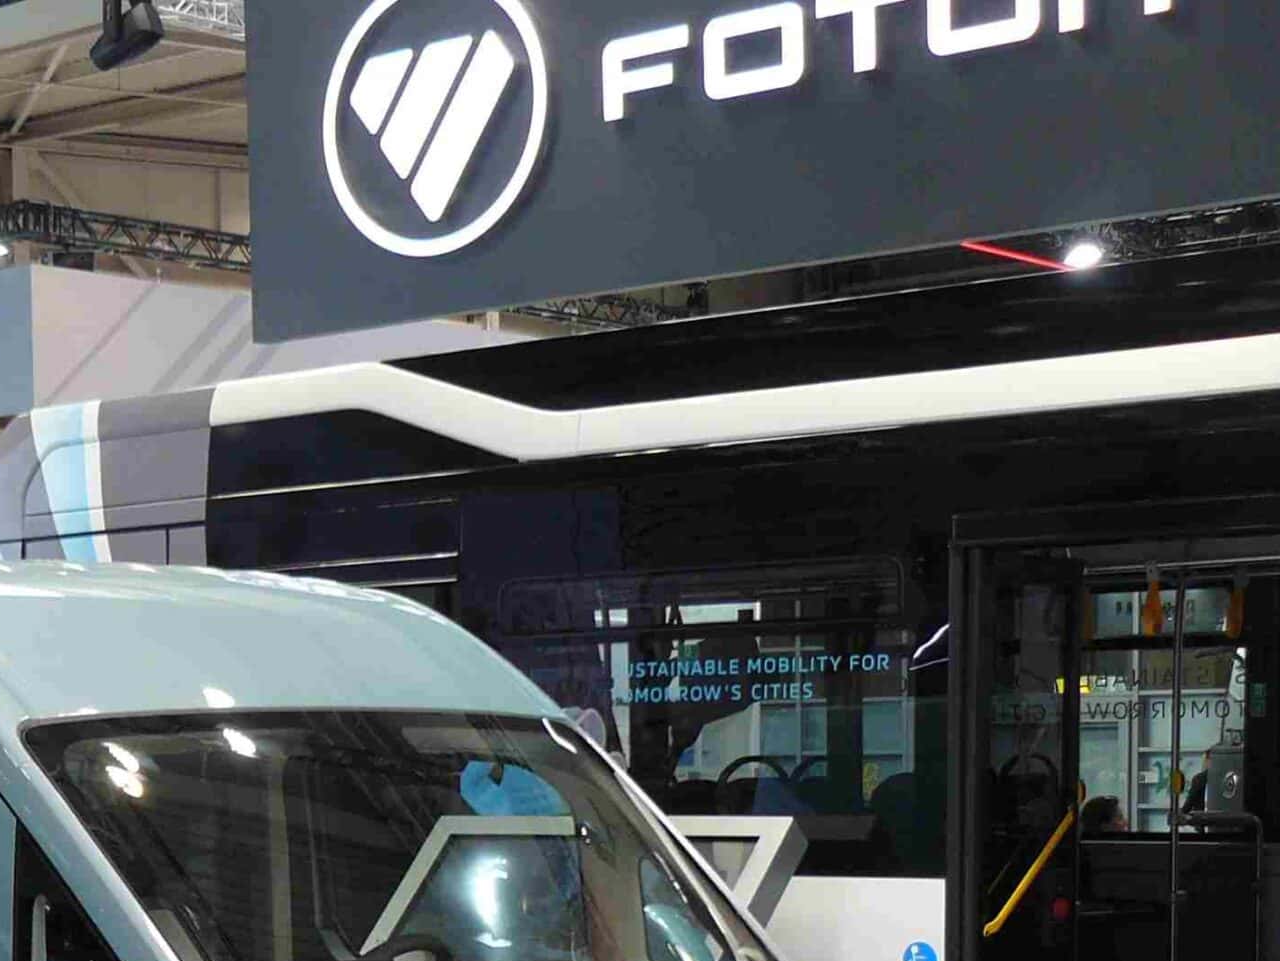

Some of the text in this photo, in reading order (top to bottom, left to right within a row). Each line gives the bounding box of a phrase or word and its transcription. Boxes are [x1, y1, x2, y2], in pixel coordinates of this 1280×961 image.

[602, 0, 1172, 122] FOTO
[622, 653, 891, 679] USTAINABLE MOBILITY FOR
[614, 682, 814, 703] OMORROW'S CITIES
